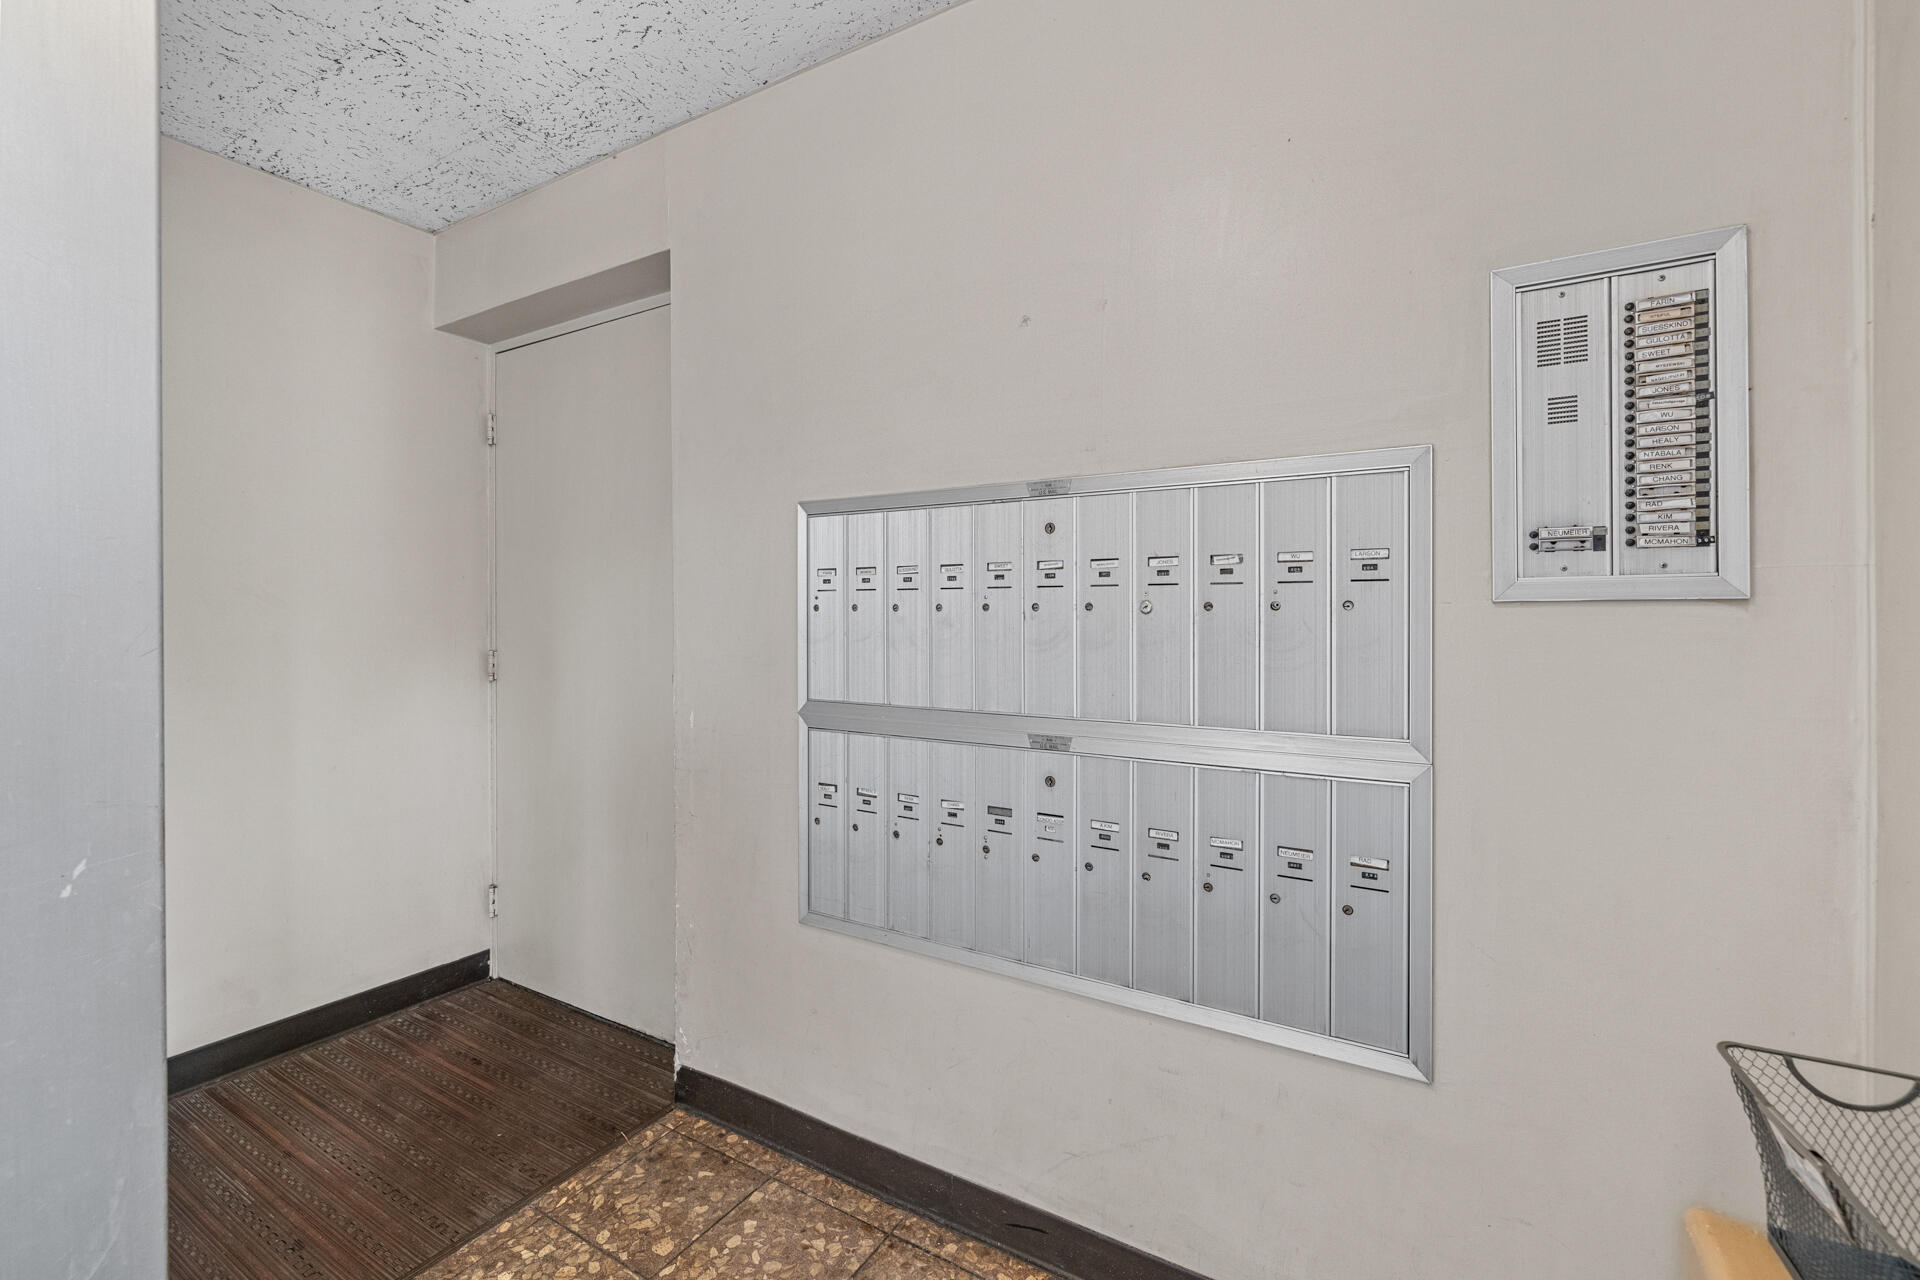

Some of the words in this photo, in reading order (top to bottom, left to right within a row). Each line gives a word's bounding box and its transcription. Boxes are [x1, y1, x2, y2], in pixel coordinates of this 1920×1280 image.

[1650, 298, 1676, 307] FARIN
[1641, 320, 1689, 333] SUESSKIND
[1641, 348, 1671, 358] SWEET
[1652, 385, 1680, 393] JONES
[1645, 424, 1680, 433] LARSON
[1652, 435, 1680, 444] HEALY
[1643, 449, 1682, 457] NTABALA
[1652, 474, 1683, 482] CHANG
[1547, 528, 1588, 537] NEUMEIER
